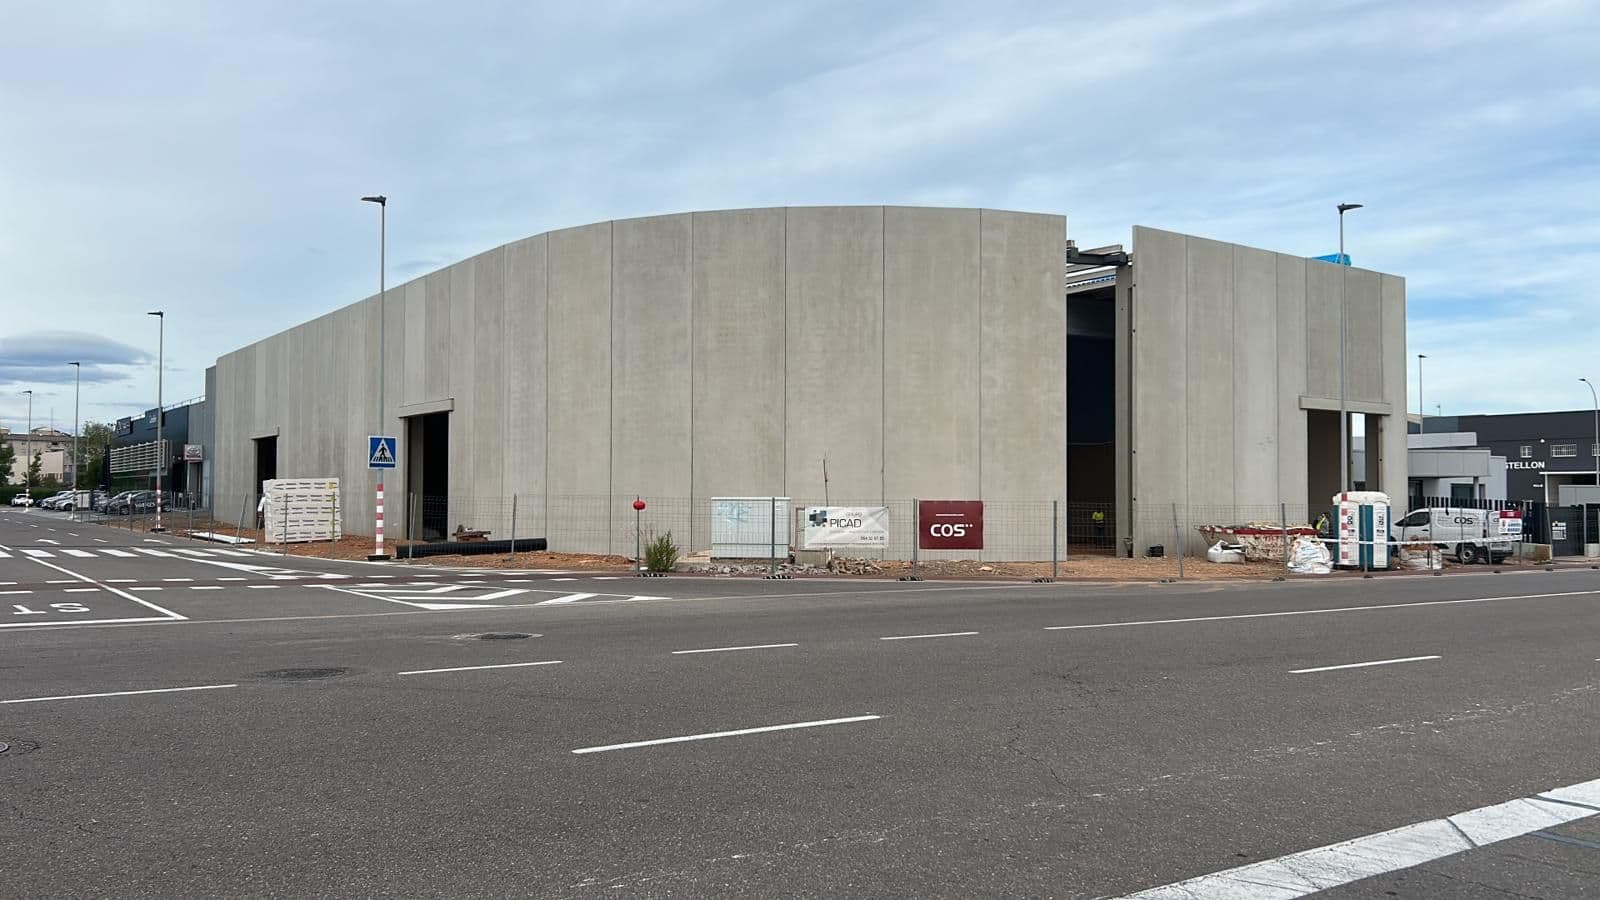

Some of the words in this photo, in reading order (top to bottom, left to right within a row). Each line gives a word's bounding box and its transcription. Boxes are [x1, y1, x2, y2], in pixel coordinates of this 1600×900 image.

[829, 518, 862, 528] PICAD
[1454, 517, 1474, 525] COS
[930, 524, 966, 537] COS
